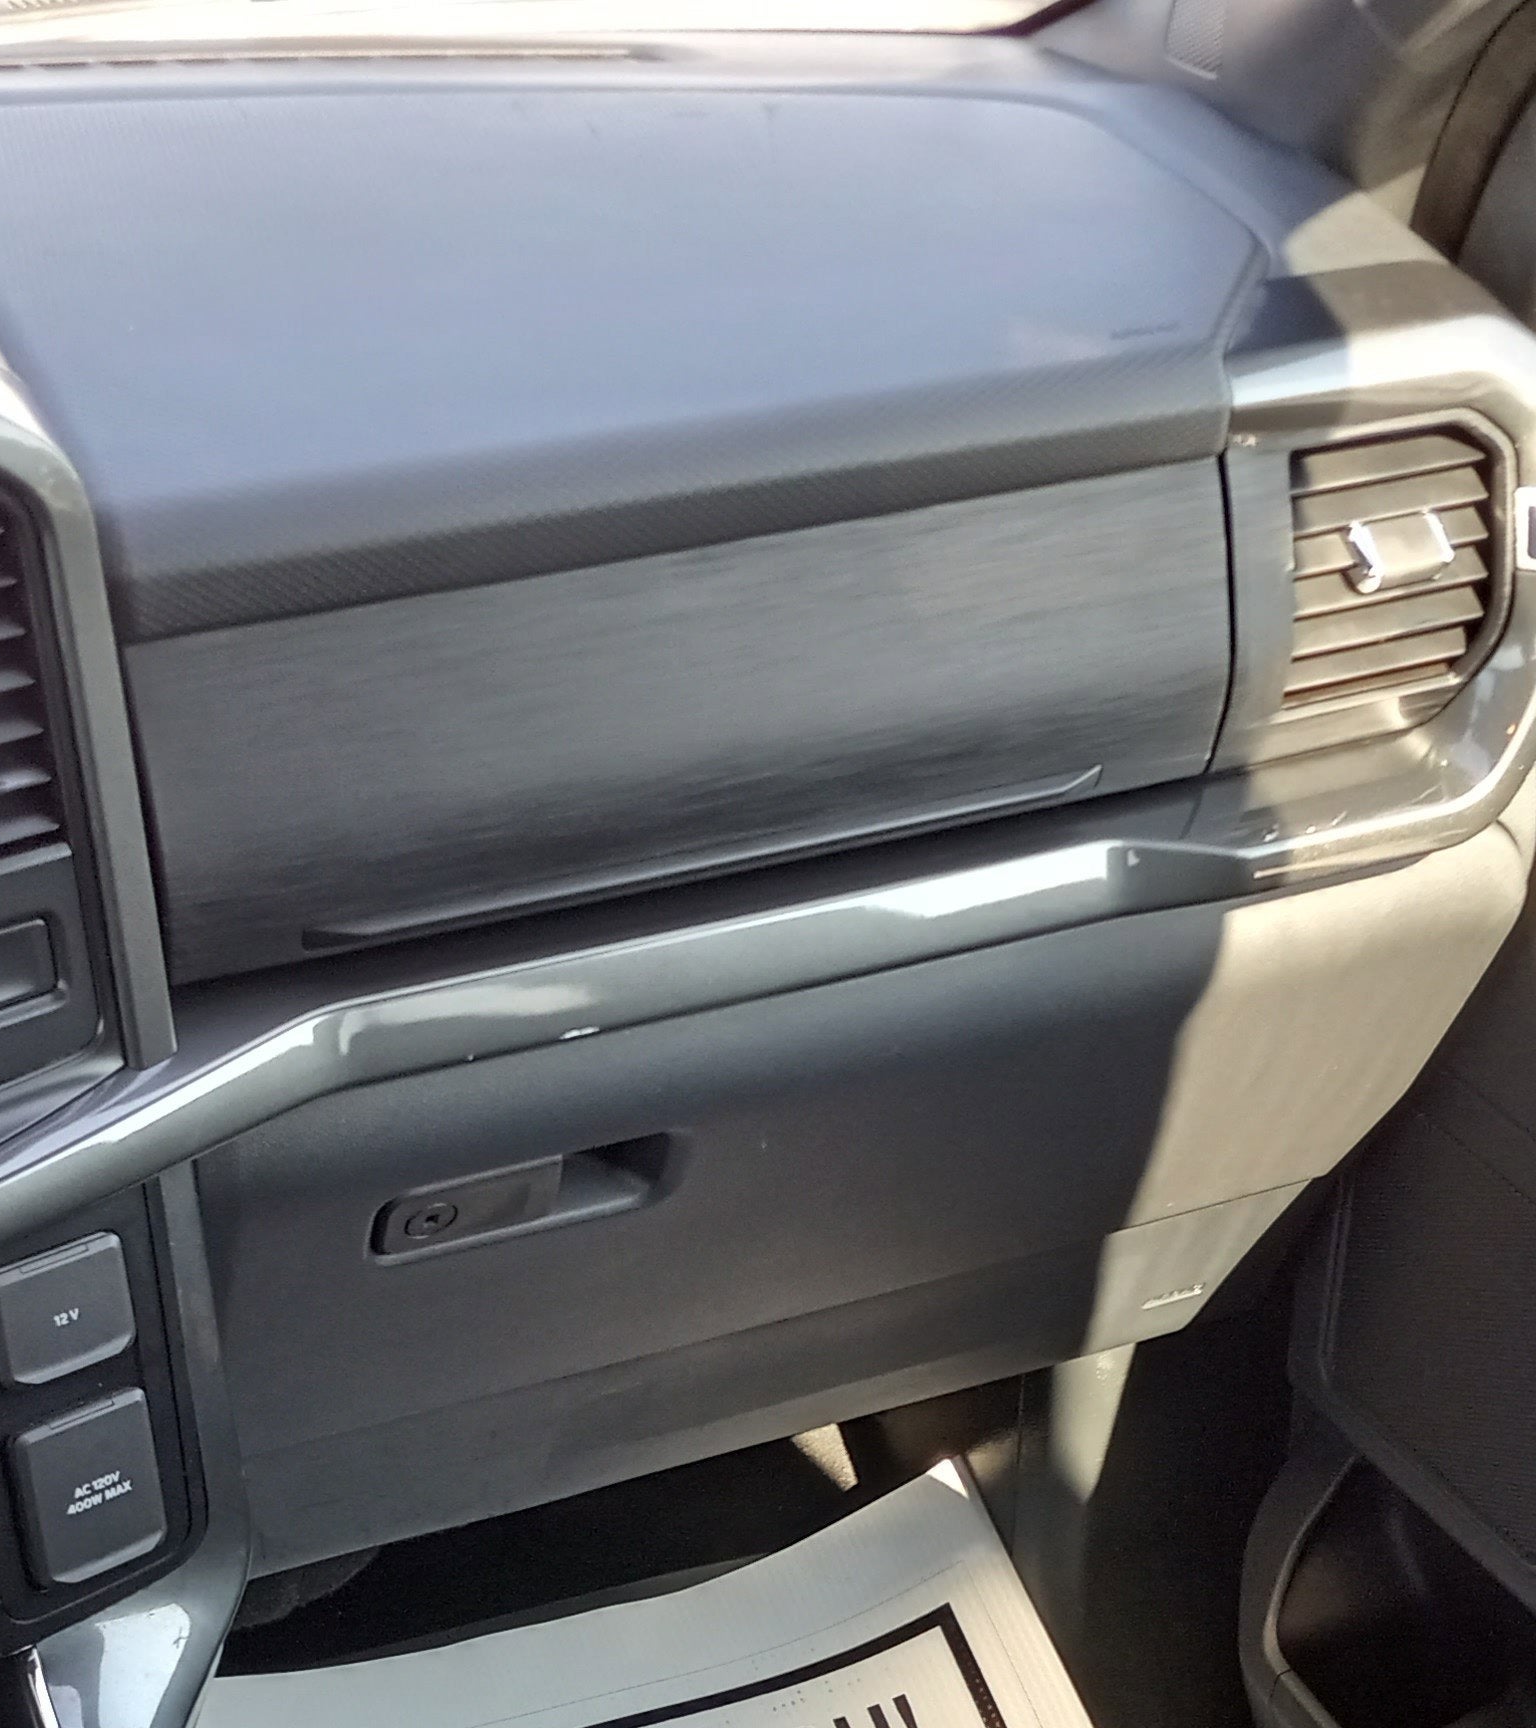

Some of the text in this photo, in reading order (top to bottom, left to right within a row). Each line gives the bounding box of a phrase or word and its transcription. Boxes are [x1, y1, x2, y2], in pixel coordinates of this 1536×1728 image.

[74, 1470, 121, 1499] AC 120V
[104, 1479, 133, 1500] MAX
